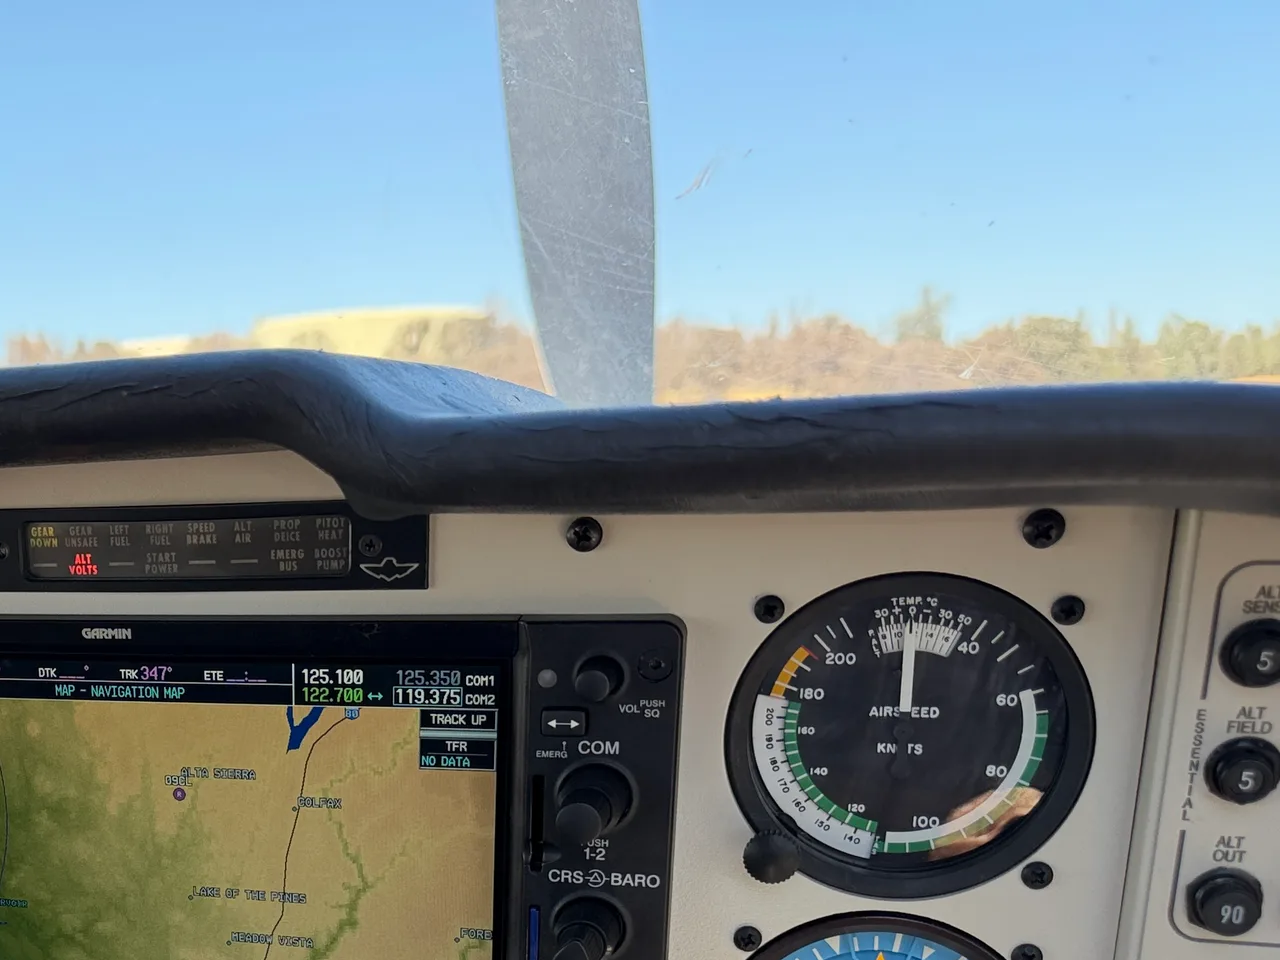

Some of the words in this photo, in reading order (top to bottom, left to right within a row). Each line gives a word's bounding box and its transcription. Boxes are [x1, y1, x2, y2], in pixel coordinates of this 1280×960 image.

[187, 522, 216, 533] SPEED
[316, 517, 345, 529] PITOT
[31, 526, 55, 537] GEAR
[69, 526, 93, 536] GEAR
[109, 525, 130, 535] LEFT
[318, 529, 343, 541] HEAT
[65, 537, 99, 548] UNSAFE
[110, 536, 131, 546] FUEL
[150, 534, 171, 545] FUEL
[186, 533, 217, 545] BRAKE
[74, 553, 93, 564] ALT
[146, 553, 177, 563] START
[270, 549, 304, 560] EMERG
[68, 563, 98, 575] VOLTS
[145, 563, 178, 574] POWER
[279, 560, 298, 571] BUS
[317, 559, 345, 570] PUMP
[82, 628, 132, 639] GARMIN
[958, 642, 979, 654] 40
[825, 653, 856, 665] 200
[38, 667, 56, 678] DTK
[120, 668, 138, 679] TRK
[204, 670, 224, 681] ETE
[302, 669, 363, 684] 125.100
[396, 670, 461, 686] 125.350
[466, 675, 494, 686] COM1
[55, 684, 75, 697] MAP
[91, 685, 159, 698] NAVIGATION
[164, 687, 185, 699] MAP
[302, 687, 363, 702] 122.700
[395, 689, 461, 705] 119.375
[465, 694, 495, 705] COM2
[800, 688, 824, 700] 180
[640, 700, 665, 708] PUSH
[996, 694, 1018, 707] 60
[619, 704, 640, 714] VOL
[644, 708, 660, 718] SQ
[1236, 706, 1266, 720] ALT
[430, 713, 467, 725] TRACK
[471, 714, 487, 725] UP
[798, 727, 815, 735] 160
[1226, 720, 1272, 734] FIELD
[446, 741, 468, 752] TFR
[578, 741, 620, 755] COM
[536, 750, 568, 758] EMERG
[421, 756, 436, 766] NO
[439, 756, 470, 767] DATA
[213, 768, 257, 780] SIERRA
[810, 767, 828, 776] 140
[986, 766, 1007, 778] 80
[1238, 772, 1254, 790] 5
[297, 797, 342, 810] COLFAX
[848, 803, 865, 812] 120
[912, 815, 940, 828] 100
[1216, 836, 1245, 849] ALT
[583, 848, 606, 860] 1-2
[1212, 850, 1246, 863] OUT
[548, 869, 584, 884] CRS
[610, 872, 660, 887] BARO
[192, 887, 220, 899] LAKE
[225, 889, 240, 899] OF
[244, 890, 266, 901] THE
[271, 892, 306, 904] PINES
[1220, 905, 1244, 924] 90
[231, 932, 273, 944] MEADOW
[278, 936, 314, 948] VISTA
